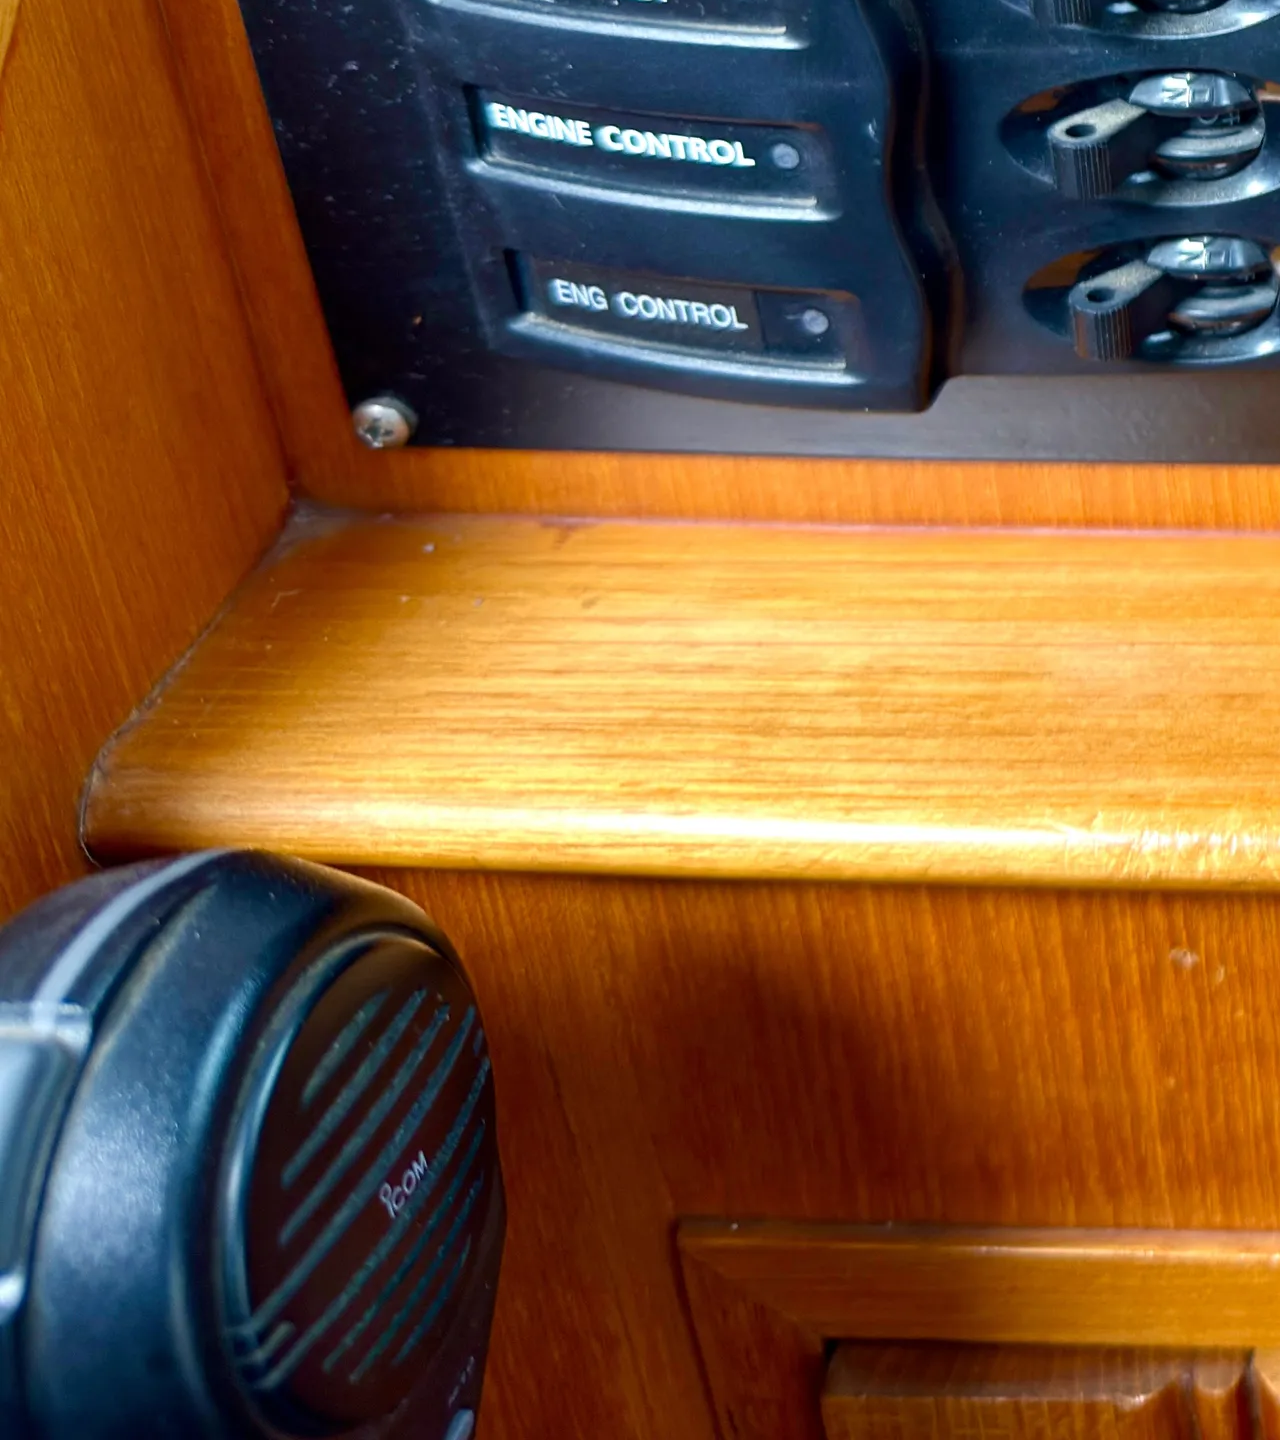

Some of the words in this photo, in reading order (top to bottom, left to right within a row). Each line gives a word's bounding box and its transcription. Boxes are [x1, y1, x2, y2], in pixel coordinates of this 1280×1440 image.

[487, 102, 593, 147] ENGINE
[594, 125, 756, 167] CONTROL
[550, 278, 608, 310] ENG
[612, 291, 749, 332] CONTROL
